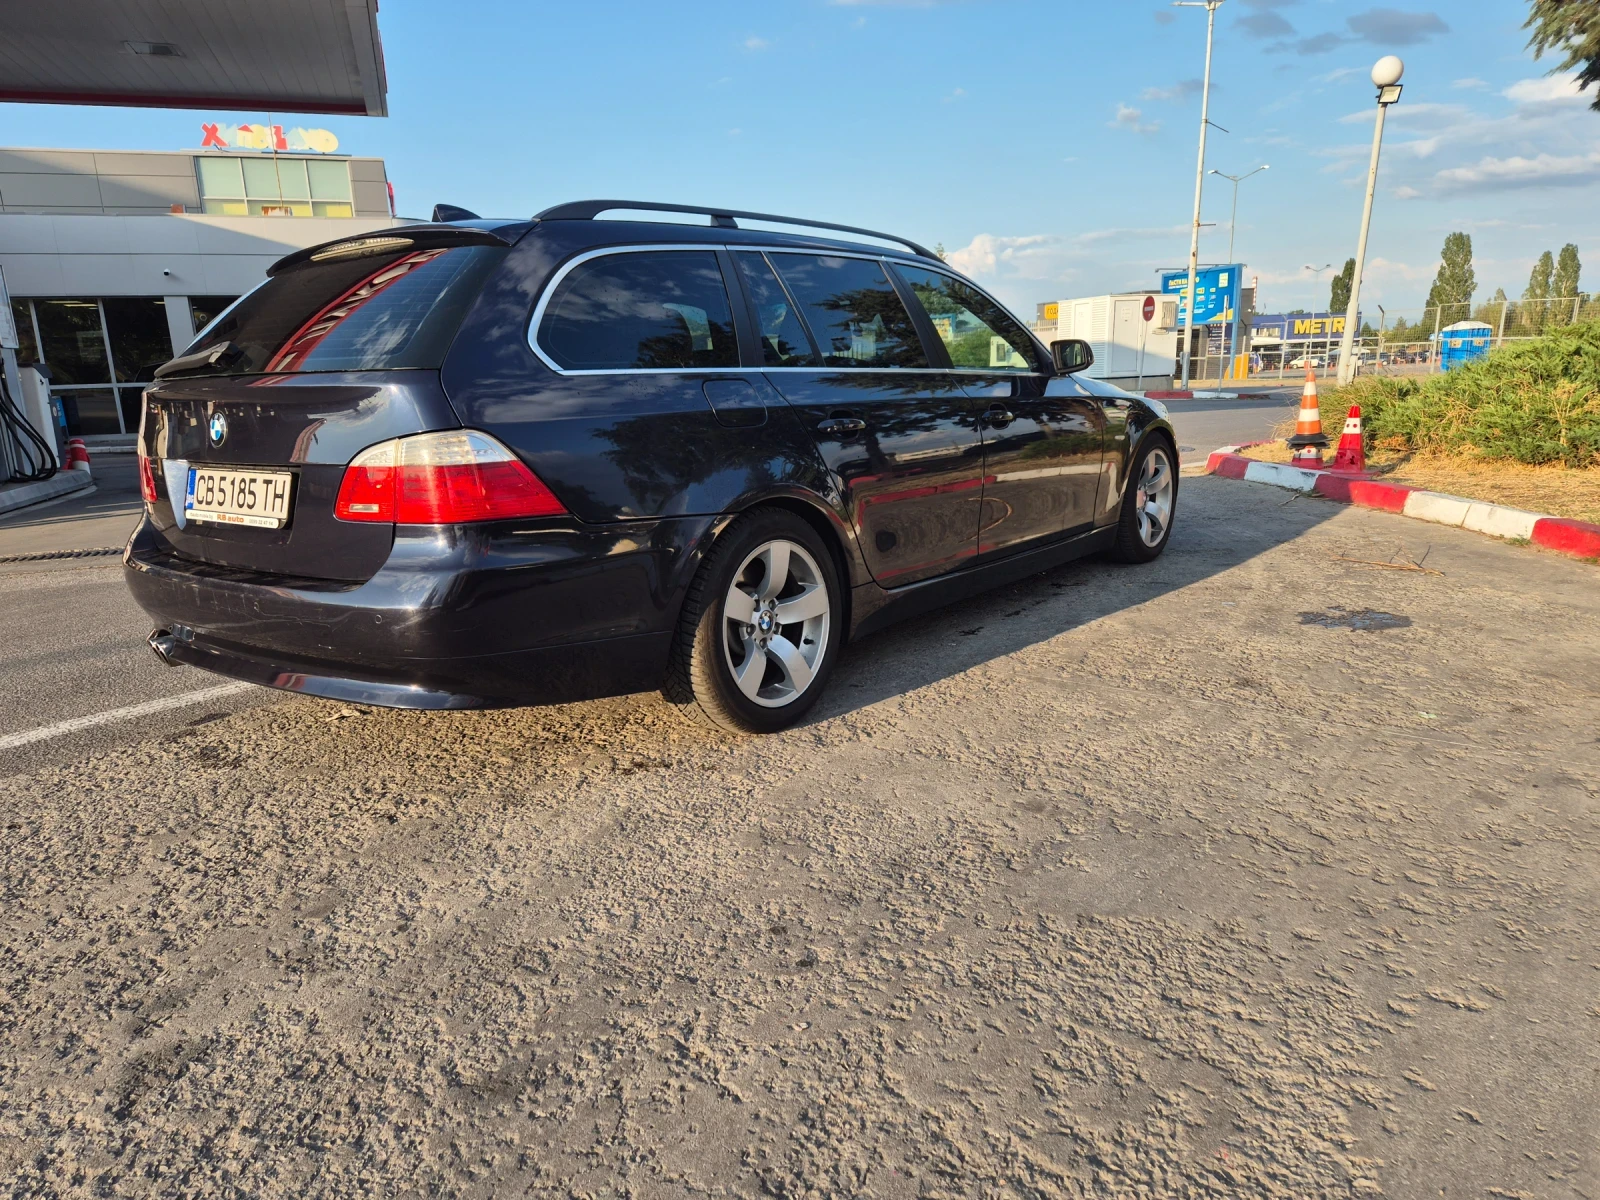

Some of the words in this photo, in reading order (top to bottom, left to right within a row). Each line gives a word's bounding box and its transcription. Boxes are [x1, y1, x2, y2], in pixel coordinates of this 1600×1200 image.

[1294, 316, 1358, 335] METR
[217, 476, 257, 510] 5185
[227, 515, 245, 523] auto
